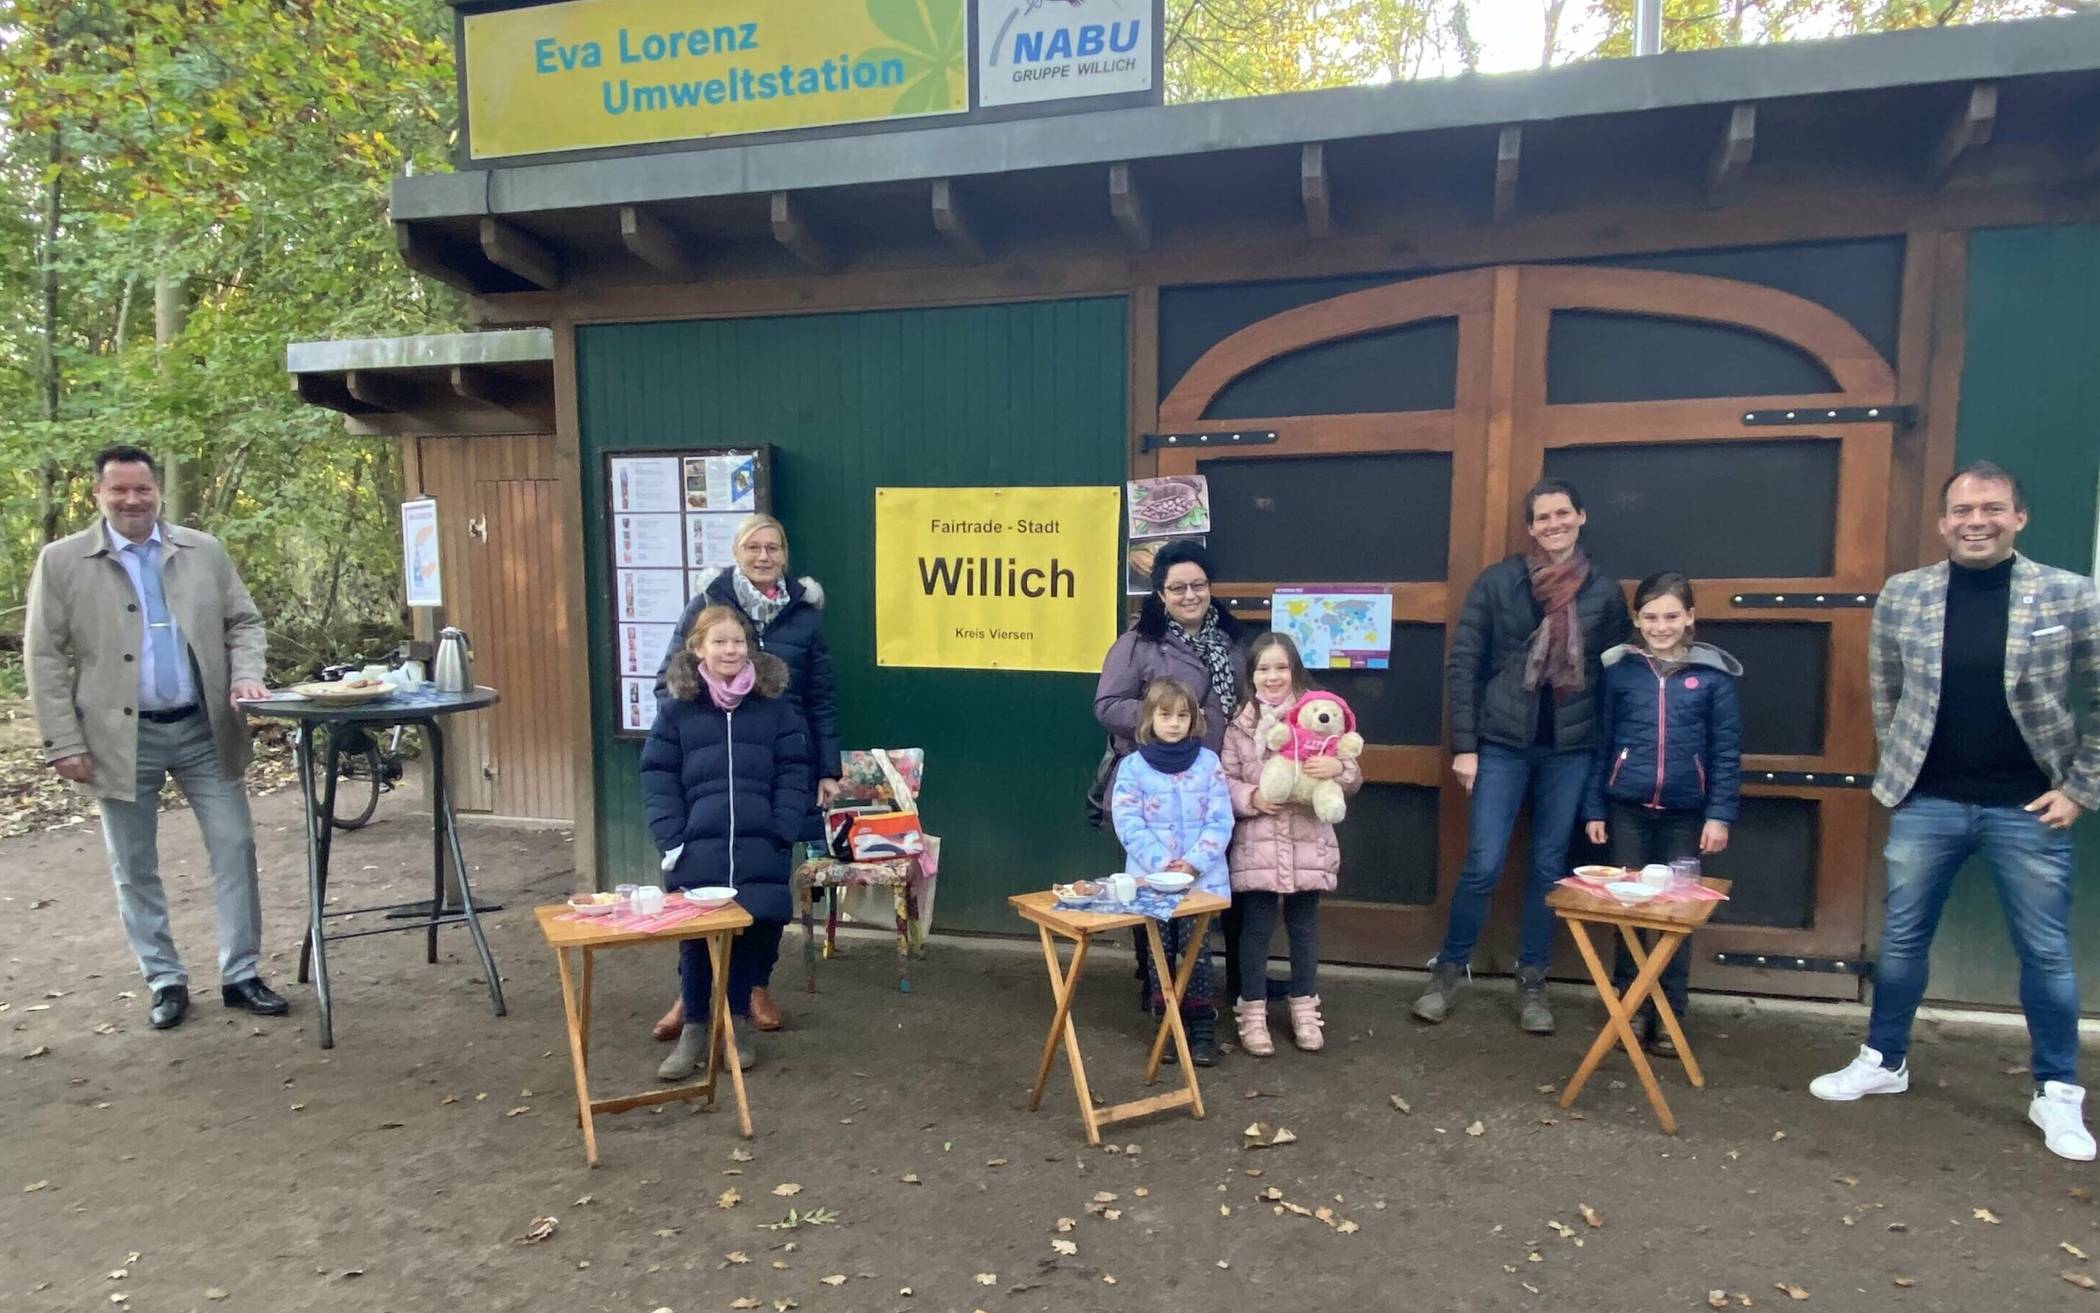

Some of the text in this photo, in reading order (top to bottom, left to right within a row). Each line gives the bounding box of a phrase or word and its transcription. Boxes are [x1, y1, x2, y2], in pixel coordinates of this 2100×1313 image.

[535, 22, 759, 75] Eva Lorenz
[1013, 19, 1141, 64] NABU
[602, 53, 905, 116] Umweltstation
[1012, 58, 1137, 83] GRUPPE WILLICH
[931, 519, 1003, 534] Fairtrade
[1017, 519, 1060, 534] Stadt
[918, 557, 1075, 598] Willich
[955, 627, 1034, 641] Kreis Viersen
